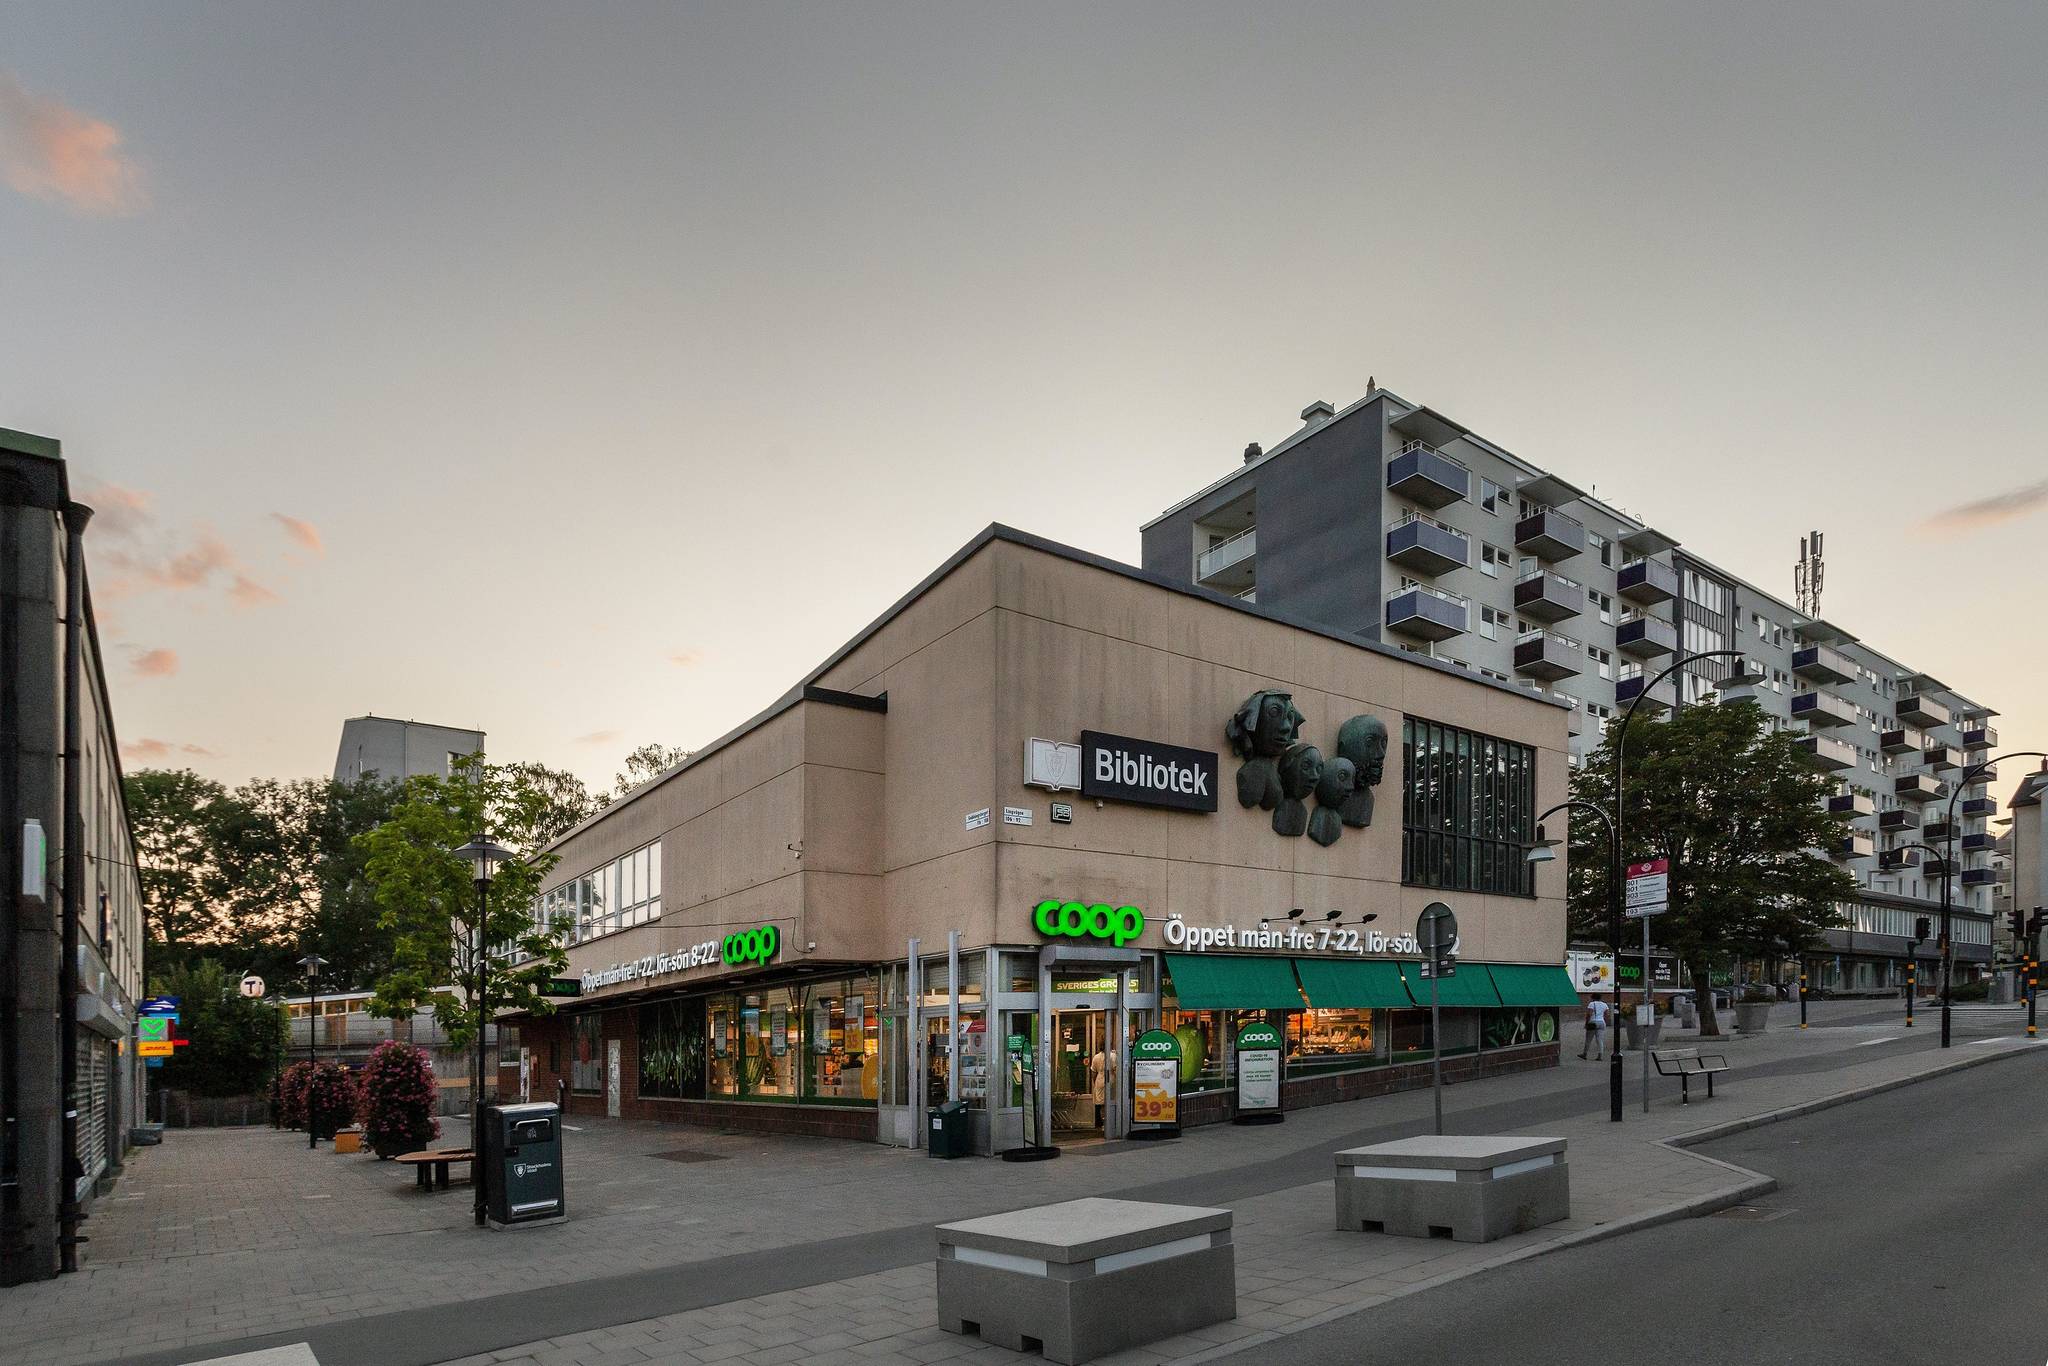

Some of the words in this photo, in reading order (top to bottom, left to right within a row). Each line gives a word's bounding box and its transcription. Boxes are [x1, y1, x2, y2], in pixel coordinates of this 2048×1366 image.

[1095, 747, 1208, 796] Bibliotek
[1033, 899, 1145, 947] coop
[1164, 913, 1235, 952] Öppet
[1241, 921, 1314, 950] mån-fre
[1316, 928, 1364, 955] 7-22,
[1367, 930, 1421, 954] lör-sön
[581, 968, 603, 992] Öppet
[603, 963, 633, 985] mån-fre
[633, 956, 656, 978] 7-22,
[656, 948, 689, 973] lör-sön
[691, 940, 717, 967] 8-22
[723, 925, 779, 967] coop
[1057, 979, 1100, 991] SVERIGES
[1142, 1042, 1172, 1052] coop
[1244, 1032, 1274, 1042] coop
[1137, 1101, 1161, 1117] 39
